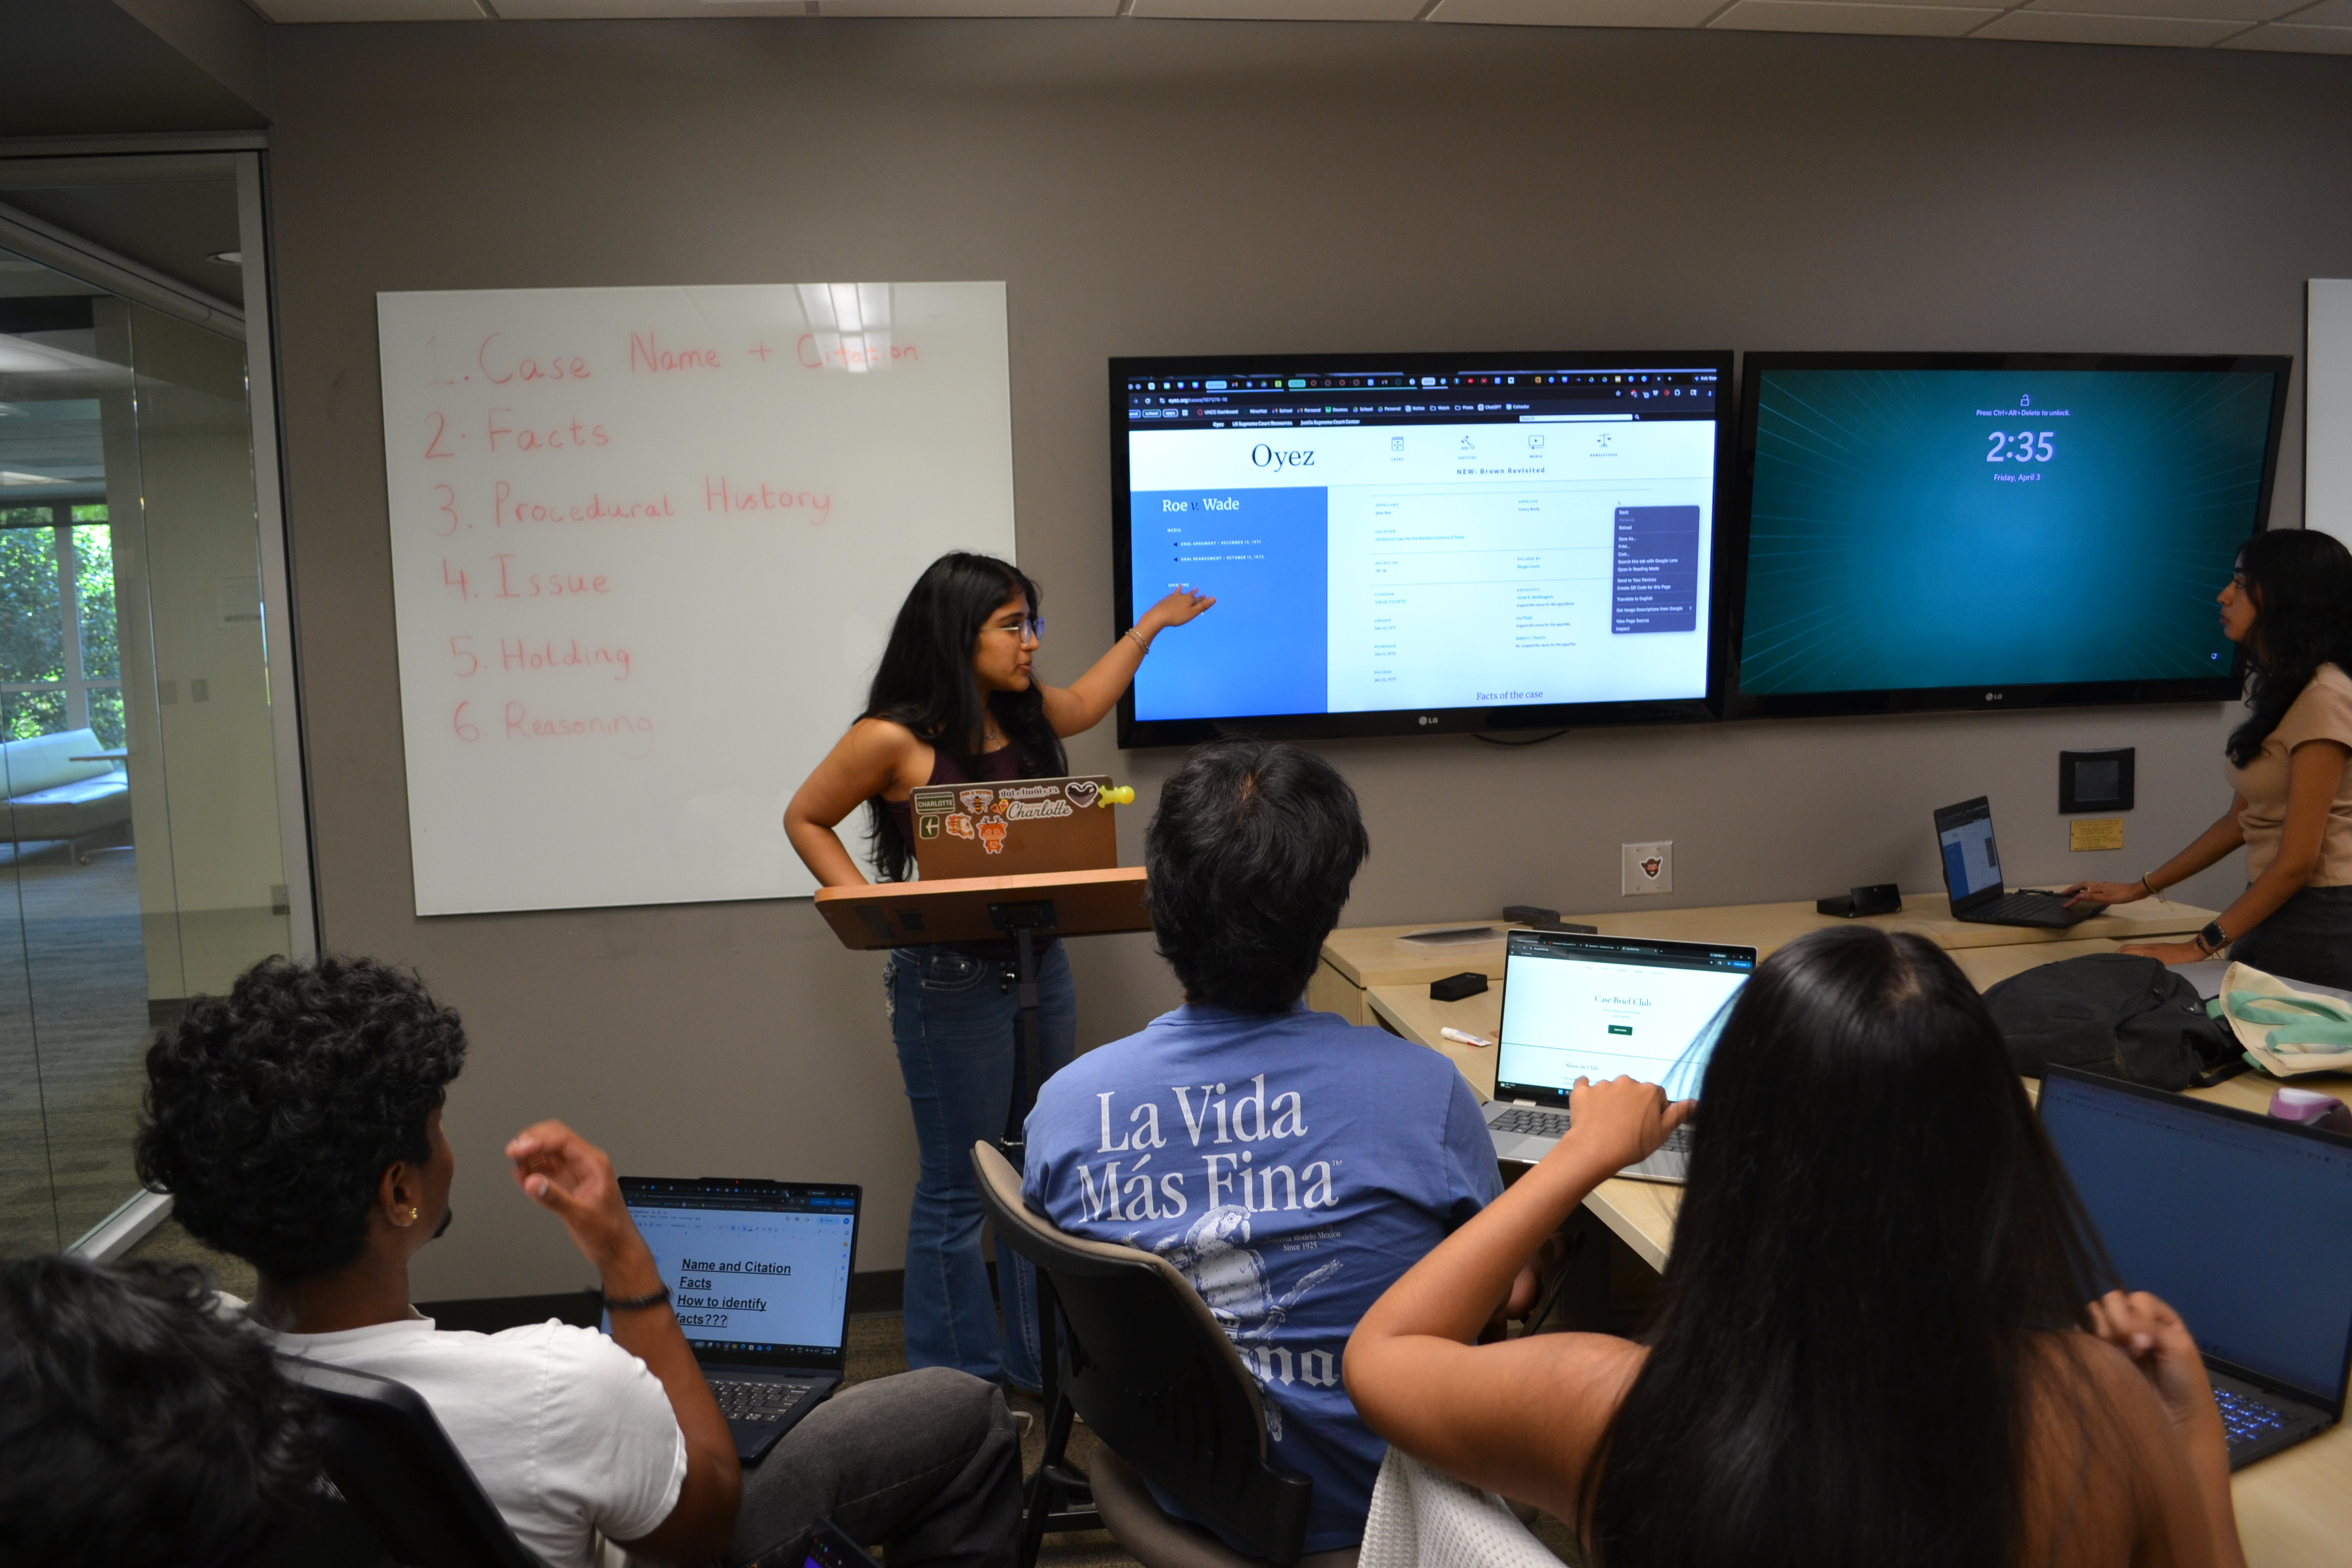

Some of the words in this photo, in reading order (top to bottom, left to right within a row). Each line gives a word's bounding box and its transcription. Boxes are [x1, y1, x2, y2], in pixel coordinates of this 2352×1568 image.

[478, 333, 591, 385] Case
[630, 332, 721, 375] Name
[797, 333, 919, 369] Citation
[488, 408, 609, 453] Facts
[1986, 431, 2054, 462] 2:35
[1251, 444, 1315, 473] Oyez
[1993, 474, 2016, 483] Friday,
[2018, 474, 2035, 482] April
[495, 481, 675, 528] Procedural
[705, 476, 832, 528] History
[1162, 499, 1188, 511] Roe
[1190, 501, 1199, 511] v.
[1202, 497, 1239, 511] Wade
[489, 554, 611, 599] Issue
[500, 638, 631, 681] Holding
[1476, 692, 1498, 700] Facts
[1500, 691, 1509, 699] of
[1510, 691, 1524, 699] the
[1525, 691, 1543, 699] case
[504, 701, 654, 760] Reasoning
[1009, 801, 1070, 819] Charlotte
[1633, 998, 1651, 1007] Club
[1095, 1091, 1167, 1154] La
[1171, 1073, 1309, 1147] Vida
[1076, 1154, 1188, 1223] Más
[1200, 1150, 1340, 1214] Fina
[1293, 1233, 1316, 1242] Modelo
[1303, 1241, 1317, 1250] 1925
[681, 1258, 715, 1271] Name
[719, 1261, 741, 1272] and
[745, 1261, 791, 1275] Citation
[679, 1277, 712, 1289] Facts
[677, 1294, 704, 1307] How
[707, 1296, 719, 1308] to
[722, 1296, 767, 1311] identify
[676, 1312, 727, 1327] facts???
